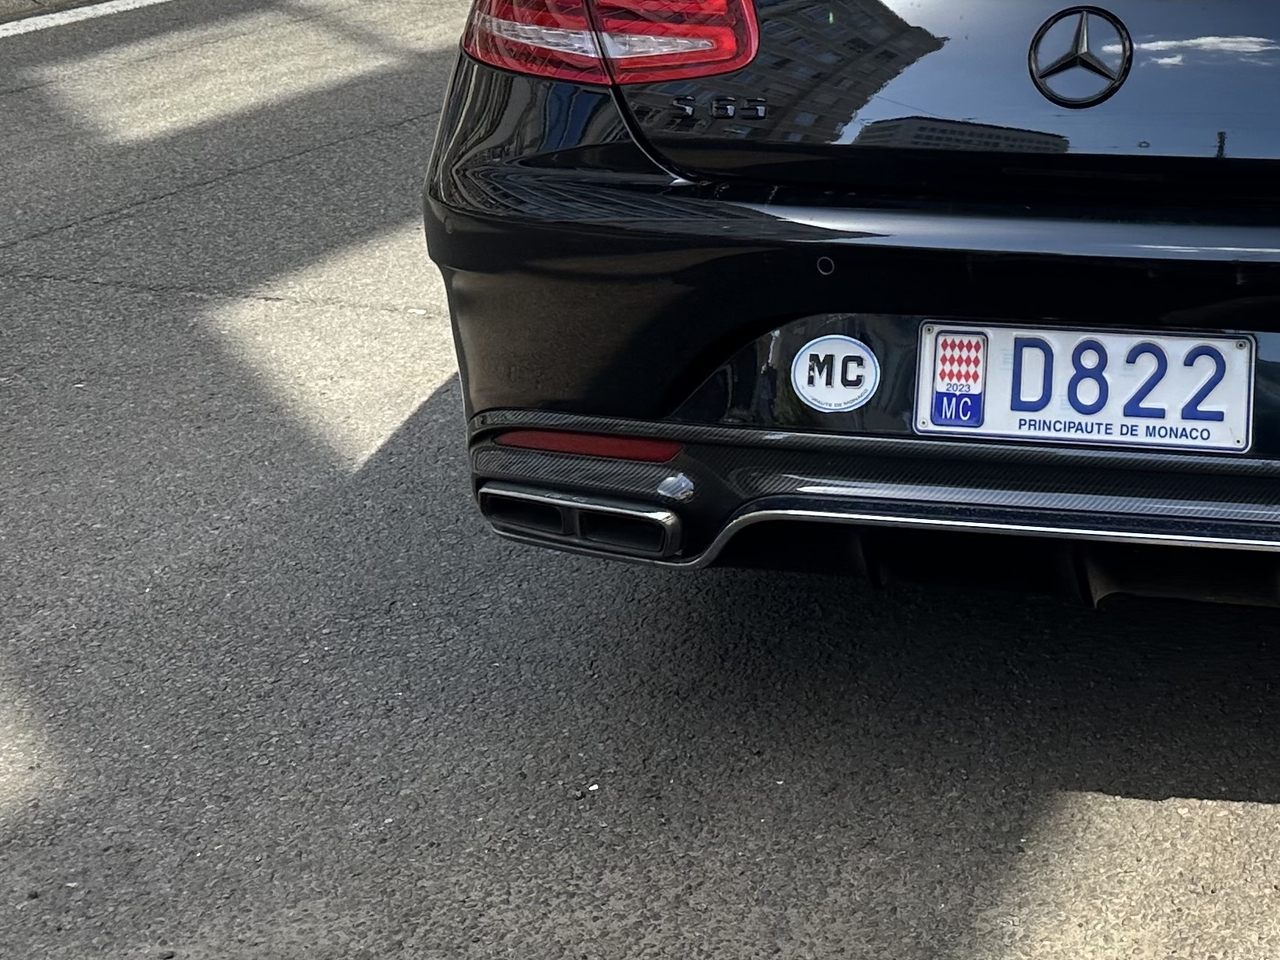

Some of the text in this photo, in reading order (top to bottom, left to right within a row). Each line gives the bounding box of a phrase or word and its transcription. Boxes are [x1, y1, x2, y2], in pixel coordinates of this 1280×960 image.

[709, 96, 767, 120] 65
[807, 353, 866, 389] MC
[1010, 336, 1227, 422] D822
[946, 382, 971, 393] 2023
[942, 397, 972, 421] MC
[1018, 418, 1211, 442] PRINCIPAUTE DE MONACO
